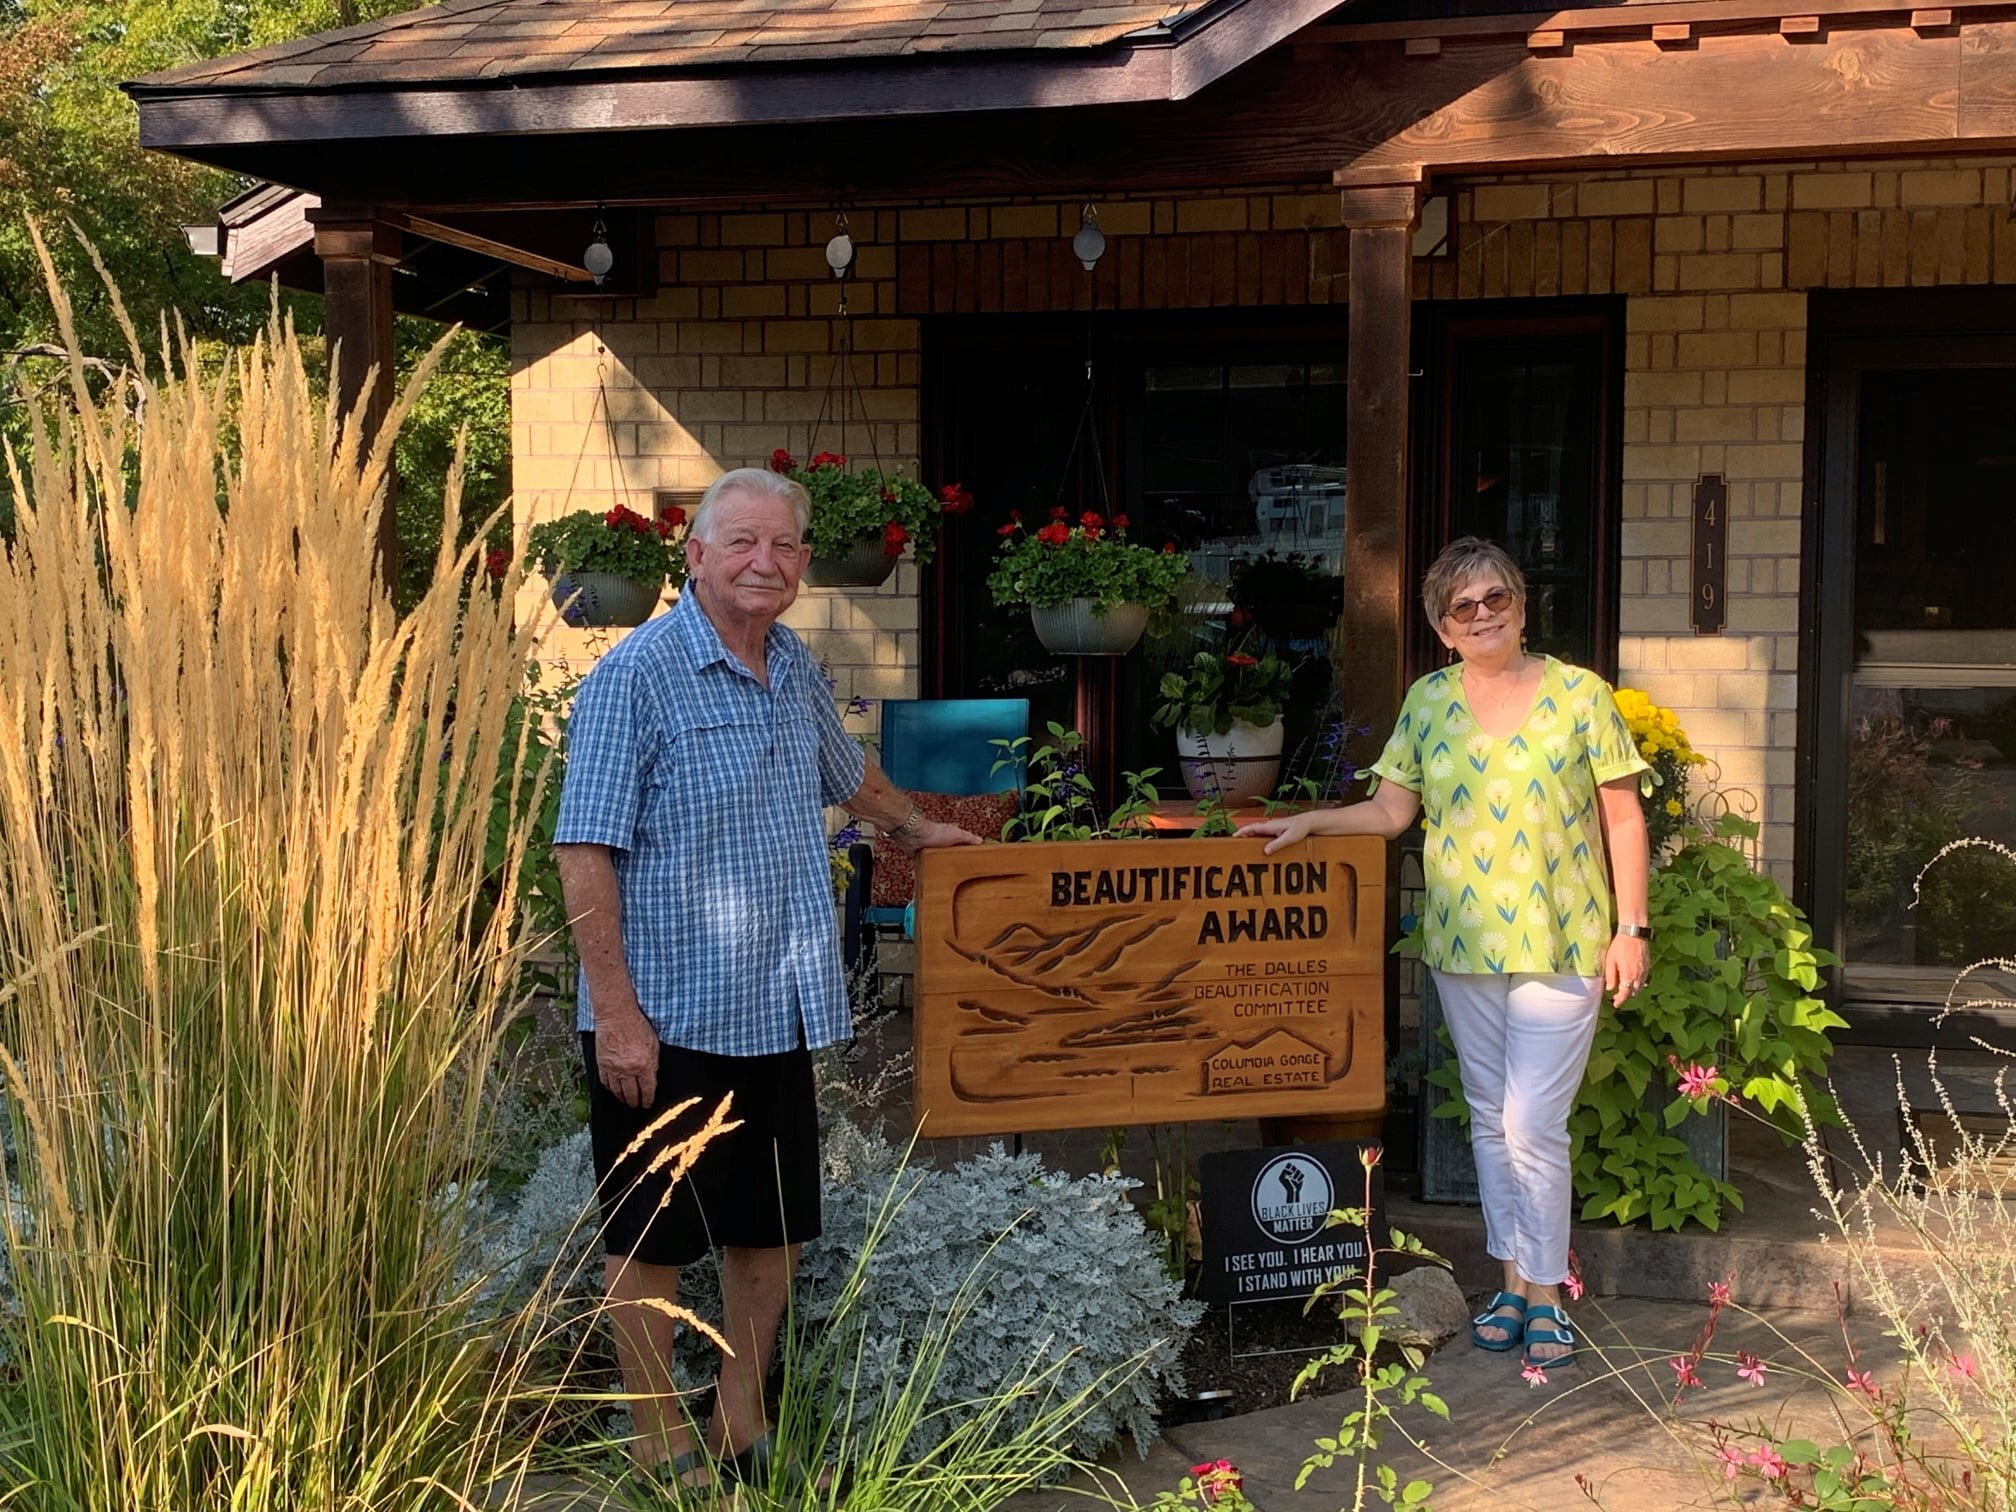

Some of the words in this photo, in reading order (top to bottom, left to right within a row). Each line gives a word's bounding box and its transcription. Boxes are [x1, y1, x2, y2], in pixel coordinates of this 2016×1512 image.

[1702, 499, 1717, 610] 419
[1050, 861, 1327, 907] BEAUTIFICATION
[1197, 906, 1328, 944] AWARD
[1224, 963, 1257, 977] THE
[1264, 960, 1328, 976] DALLES
[1194, 981, 1330, 1000] BEAUTIFICATION
[1234, 1000, 1327, 1017] COMMITTEE
[1212, 1056, 1275, 1071] COLUMBIA
[1280, 1053, 1320, 1066] GORGE
[1212, 1076, 1254, 1089] REAL
[1263, 1071, 1320, 1085] ESTATE
[1261, 1205, 1294, 1219] BLACK
[1296, 1201, 1326, 1216] LIVES
[1273, 1217, 1313, 1233] MATTER
[1225, 1256, 1230, 1272] I
[1232, 1253, 1256, 1272] SEE
[1258, 1250, 1288, 1267] YOU.
[1294, 1248, 1299, 1265] I
[1301, 1244, 1335, 1264] HEAR
[1337, 1241, 1367, 1260] YOU.
[1238, 1276, 1243, 1293] I
[1245, 1271, 1288, 1292] STAND
[1290, 1267, 1322, 1287] WITH
